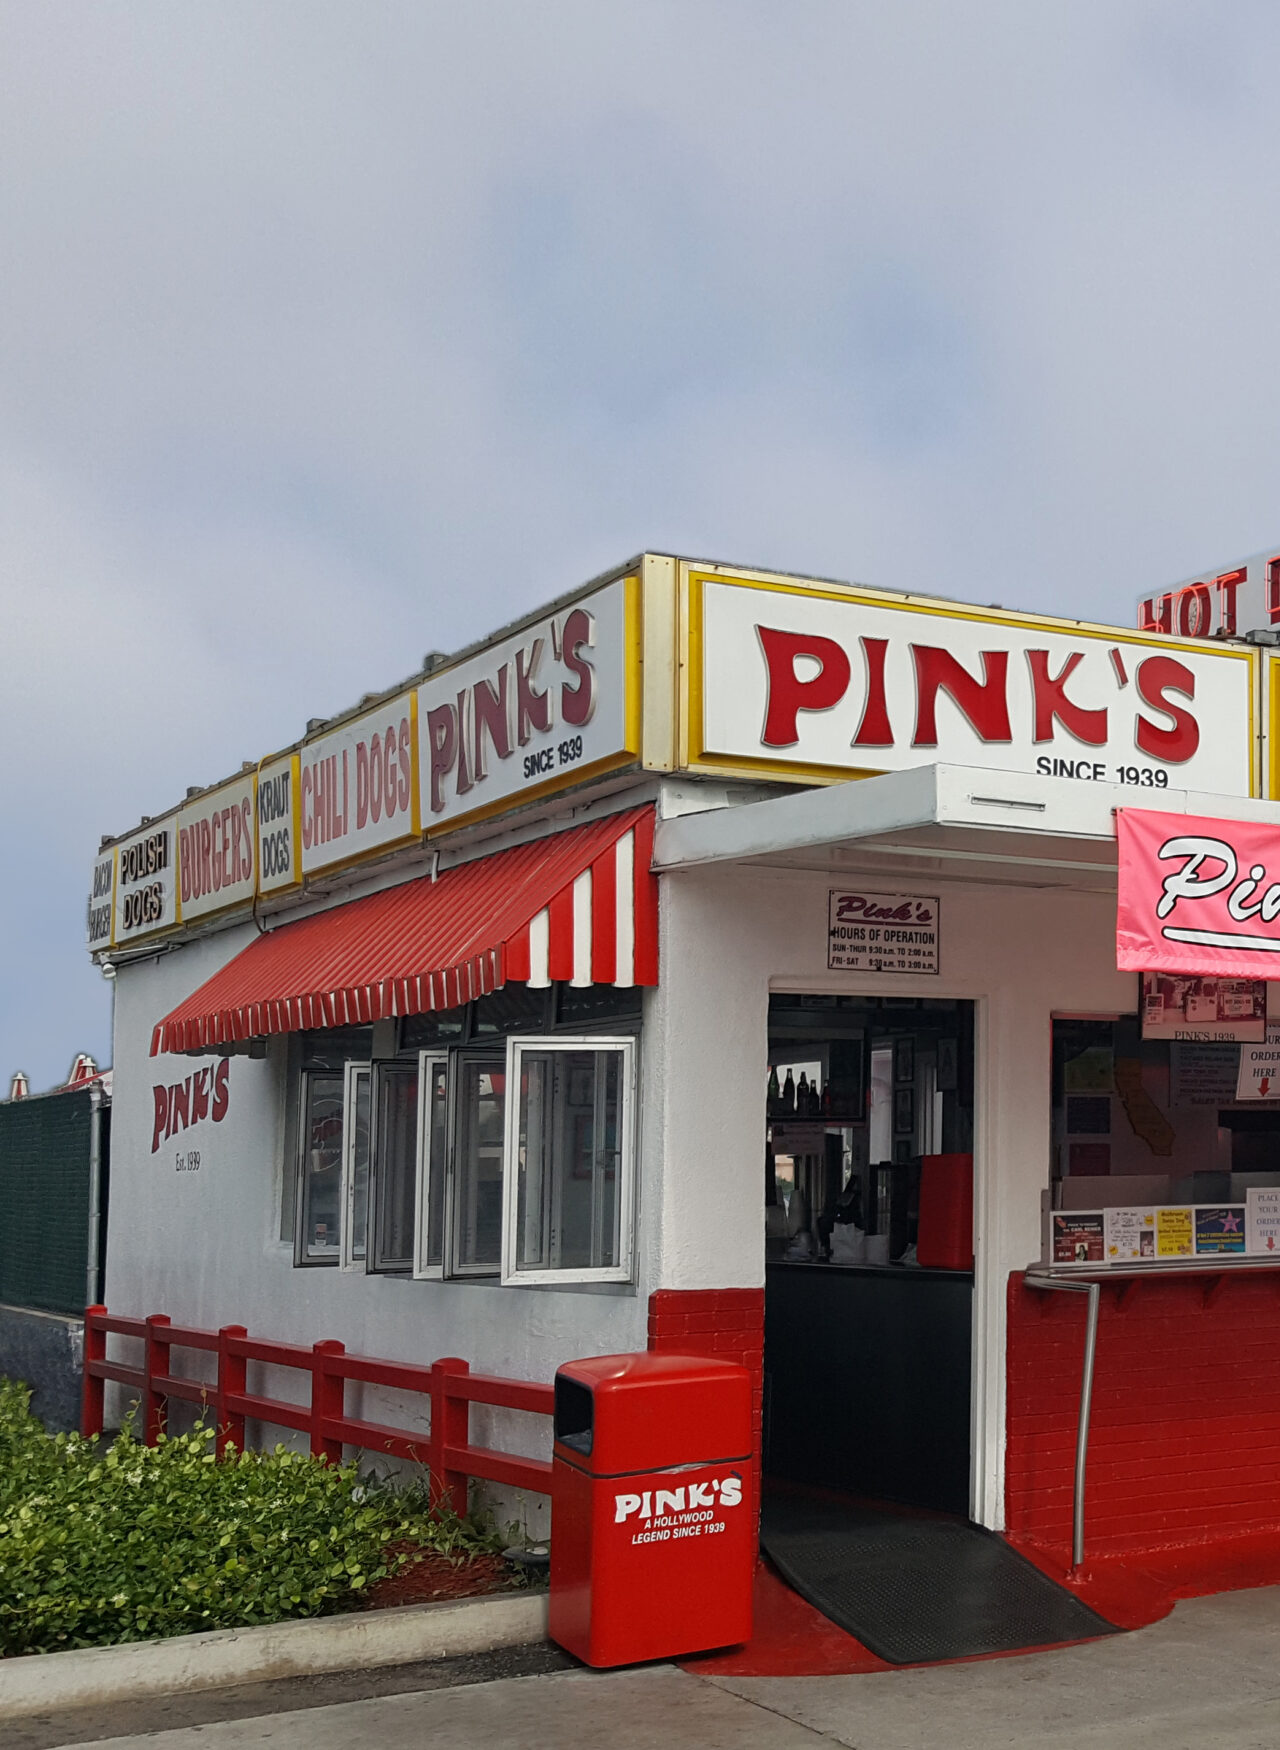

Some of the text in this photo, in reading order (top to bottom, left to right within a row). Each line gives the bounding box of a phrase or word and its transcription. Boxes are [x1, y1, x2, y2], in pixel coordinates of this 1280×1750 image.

[426, 609, 596, 813] PINK'S
[754, 624, 1201, 764] PINK'S
[524, 735, 583, 779] SINCE 1939
[1036, 756, 1168, 788] SINCE 1939
[260, 771, 291, 826] KRAUT
[302, 717, 410, 850] CHILI DOGS
[120, 831, 168, 885] POLISH
[180, 797, 252, 902] BURGERS
[263, 828, 290, 879] DOGS
[123, 882, 163, 930] DOGS
[836, 896, 933, 922] Pink's
[833, 927, 935, 944] HOURS OF OPERATION
[908, 949, 922, 957] 2:00
[1175, 1031, 1236, 1041] PINK'S 1939
[1253, 1068, 1277, 1077] HERE
[152, 1057, 230, 1154] PINK'S
[176, 1152, 201, 1171] Est. 1939
[614, 1477, 743, 1524] PINK'S
[644, 1510, 714, 1529] A HOLLYWOOD
[631, 1522, 726, 1545] LEGEND SINCE 1939
